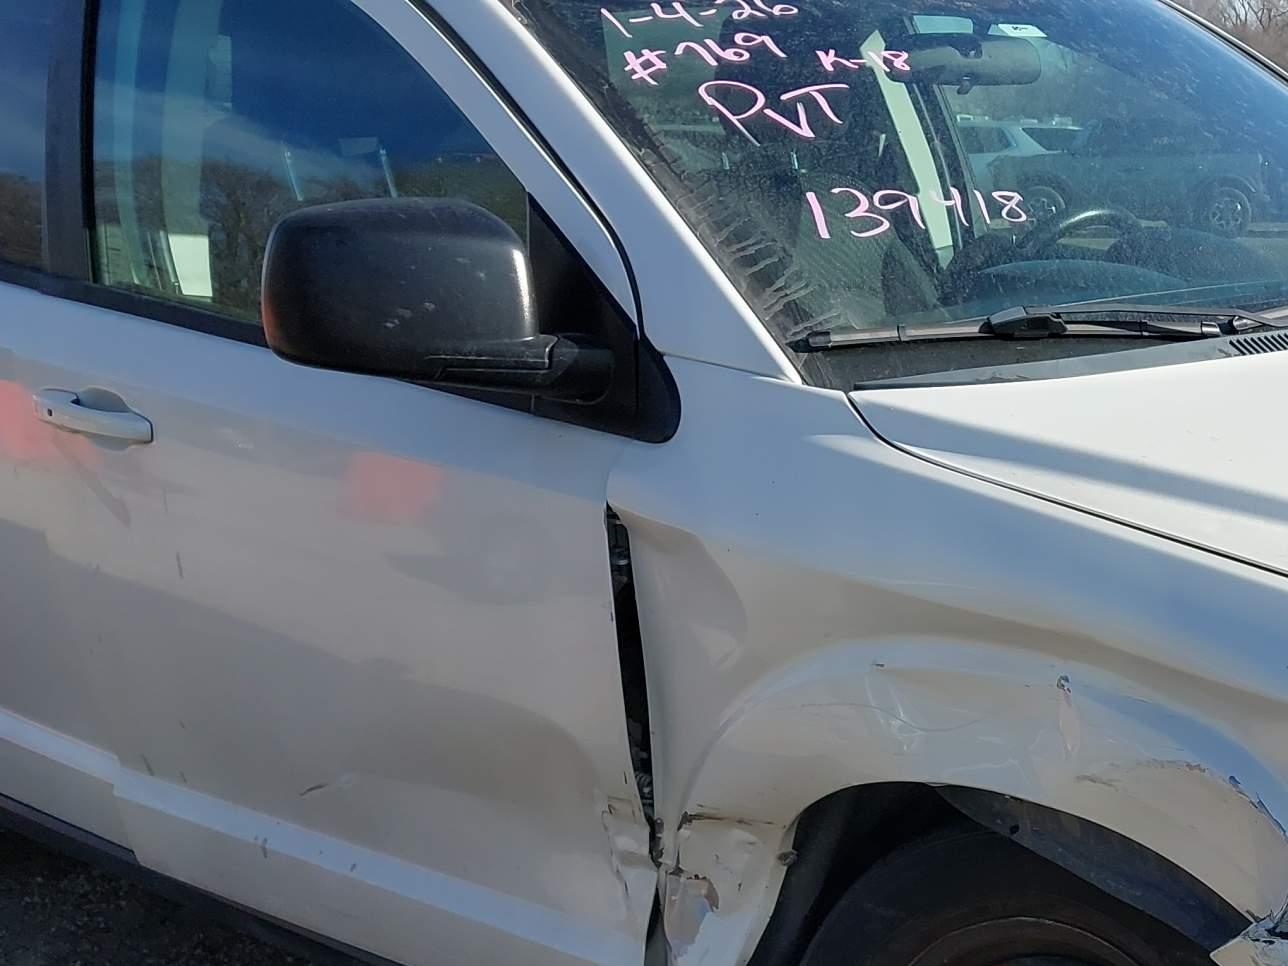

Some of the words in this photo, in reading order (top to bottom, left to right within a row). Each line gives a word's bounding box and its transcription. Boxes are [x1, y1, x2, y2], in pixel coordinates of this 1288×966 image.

[600, 0, 799, 38] 1-4-26
[698, 80, 849, 146] PVT
[805, 187, 1027, 239] 139418
